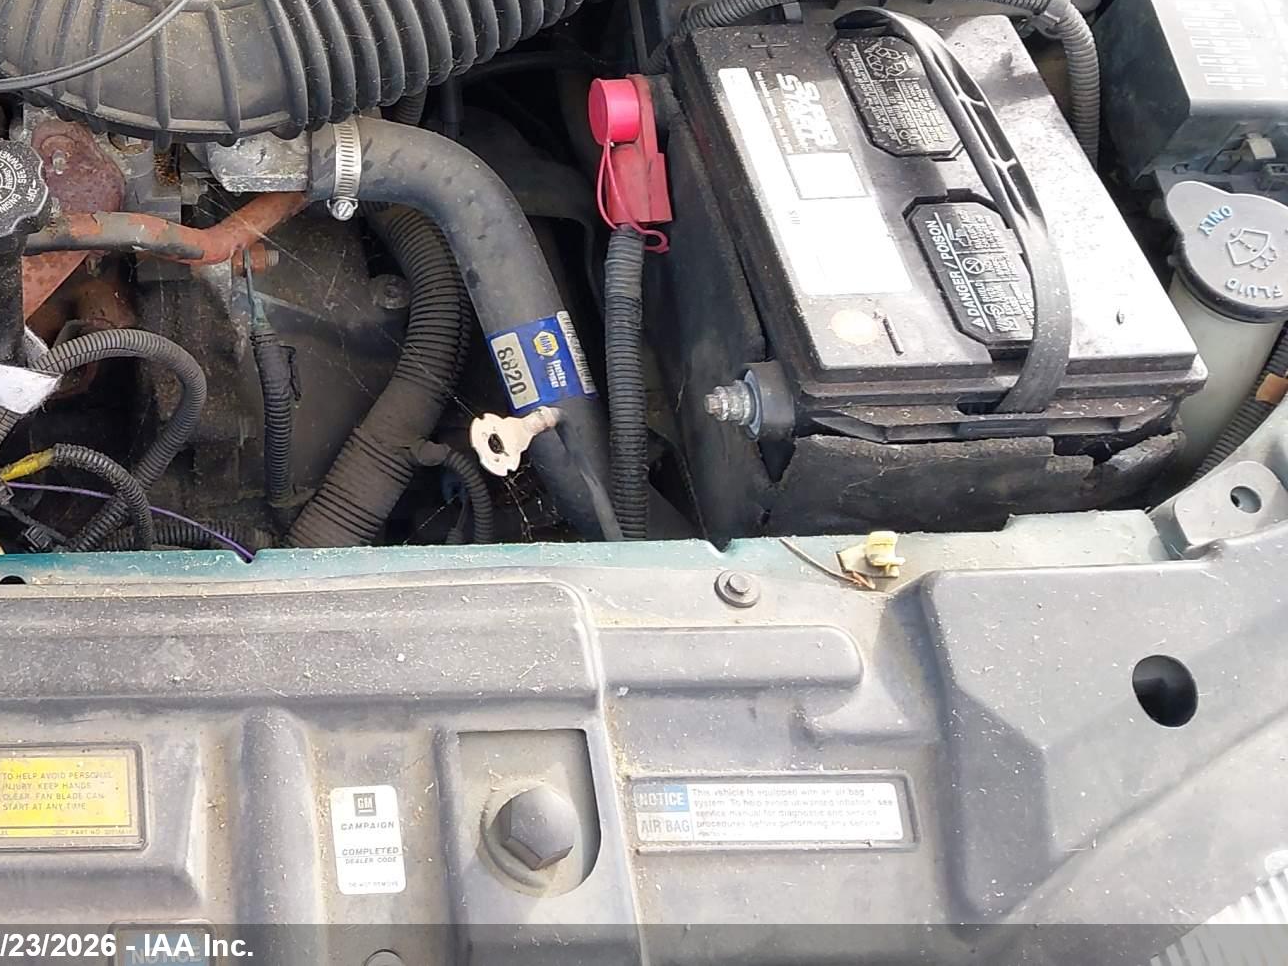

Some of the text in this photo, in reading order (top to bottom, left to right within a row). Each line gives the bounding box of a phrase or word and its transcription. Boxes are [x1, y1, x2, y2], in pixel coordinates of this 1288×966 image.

[17, 170, 27, 184] SEE
[1199, 205, 1233, 235] ONLY
[925, 220, 954, 260] POISON
[949, 271, 981, 317] DANGER
[1226, 277, 1283, 299] FLUID
[2, 772, 13, 780] TO
[16, 772, 37, 780] HELP
[62, 781, 91, 789] HANDS
[714, 787, 745, 796] vehicle
[637, 791, 686, 806] NOTICE
[2, 803, 29, 811] START
[341, 821, 395, 830] CAMPAIGN
[641, 818, 690, 833] AIR BAG
[342, 847, 399, 856] COMPLETED
